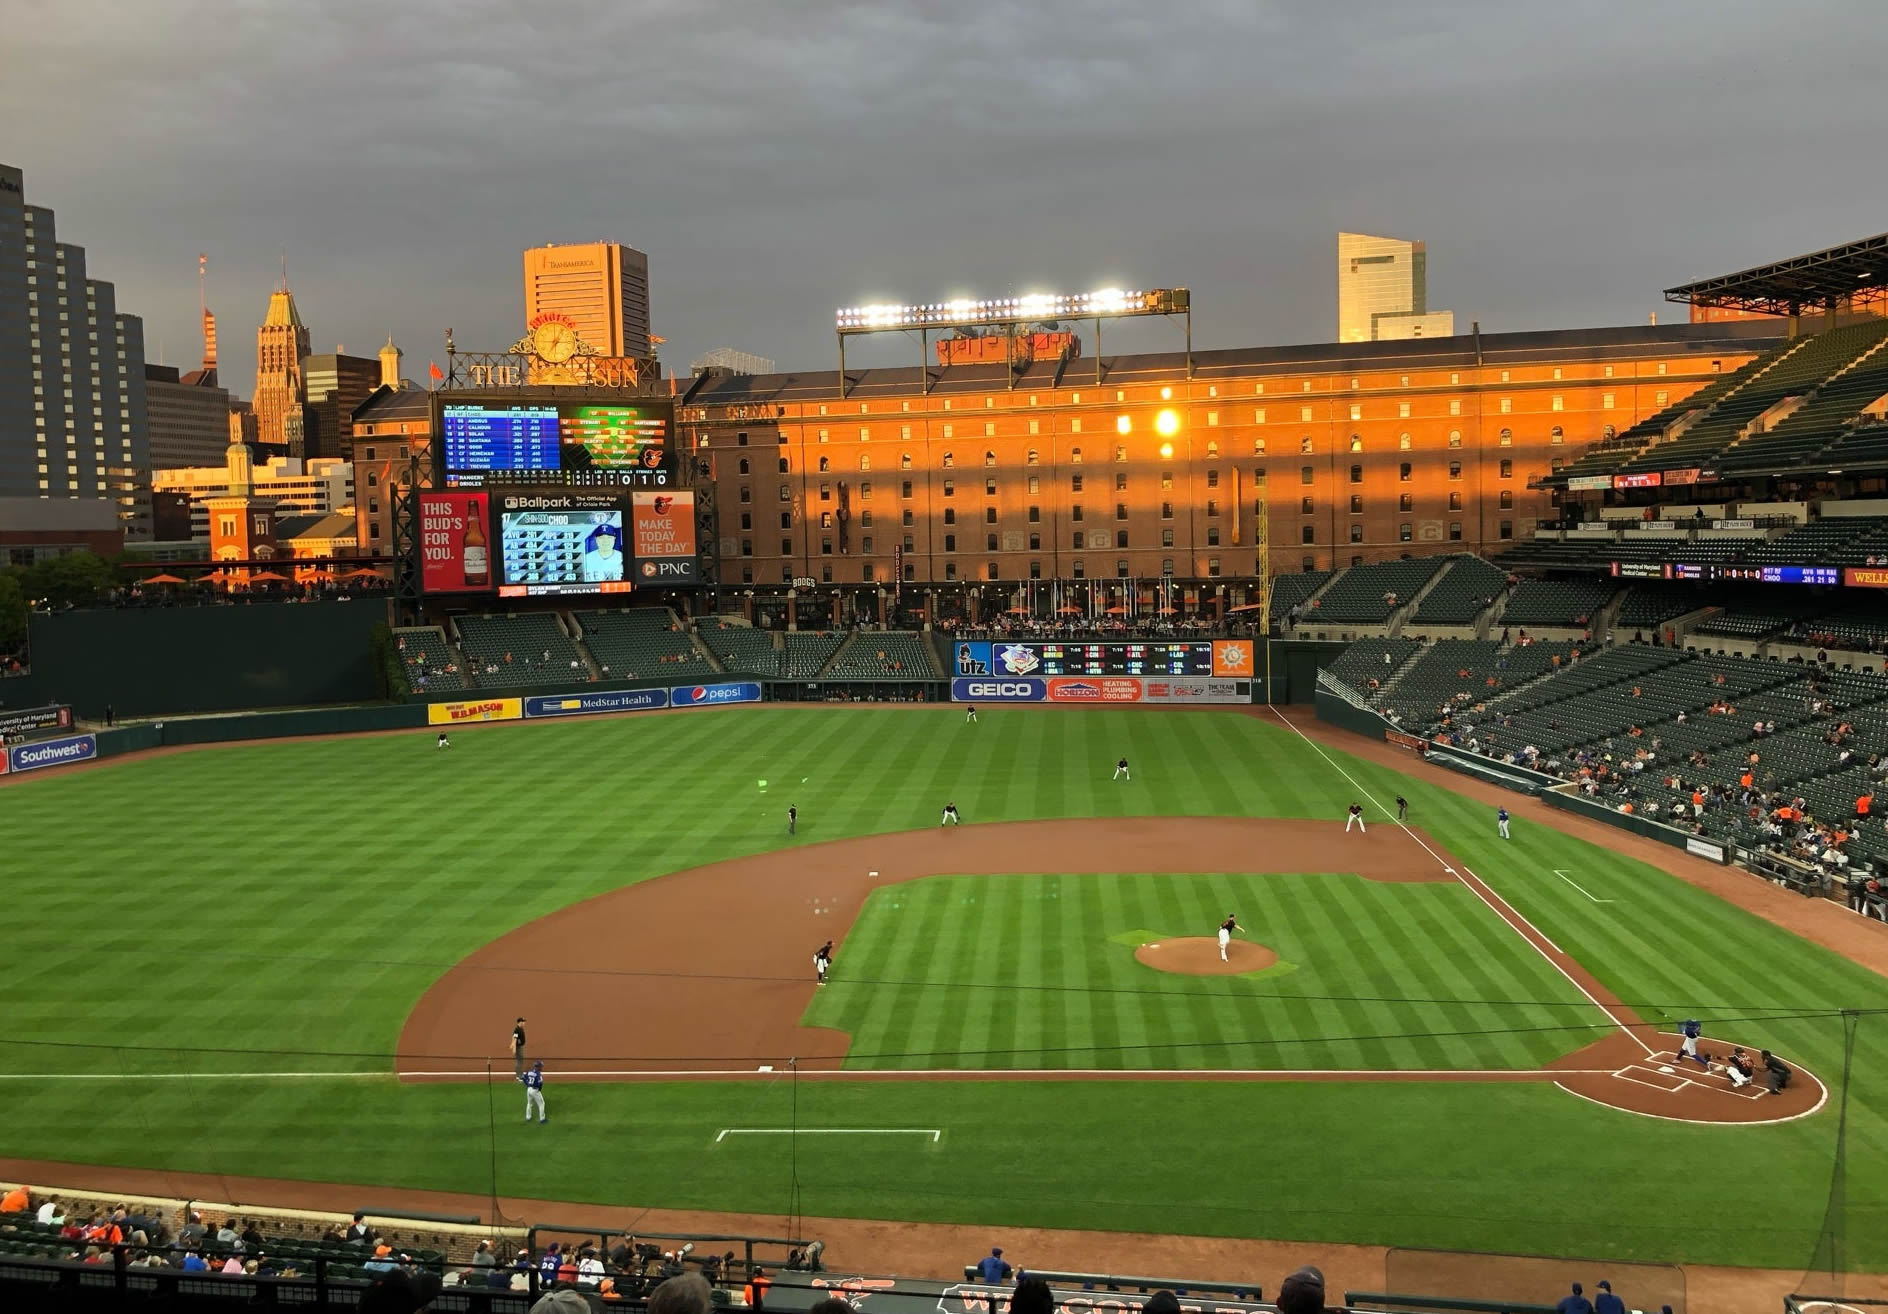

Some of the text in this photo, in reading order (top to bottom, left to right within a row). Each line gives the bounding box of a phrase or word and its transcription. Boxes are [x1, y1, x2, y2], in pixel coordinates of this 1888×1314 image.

[470, 365, 638, 388] THE SUN
[622, 475, 666, 485] 0 1 0
[423, 502, 452, 515] THIS
[519, 496, 571, 509] Ballpark
[424, 517, 463, 530] BUD'S
[502, 513, 511, 522] 17
[549, 515, 568, 525] CHOO
[639, 519, 672, 530] MAKE
[424, 532, 449, 545] FOR
[640, 531, 676, 542] TODAY
[424, 547, 455, 560] YOU.
[640, 543, 687, 553] THE DAY
[658, 562, 690, 575] PNC
[1731, 569, 1737, 578] 0
[1755, 570, 1760, 579] 0
[960, 659, 986, 675] utz
[709, 687, 741, 699] pepsi
[968, 683, 1031, 696] GEICO
[1055, 688, 1100, 696] HORIZON
[583, 695, 651, 708] MedStar Health
[31, 712, 56, 721] Maryland
[20, 743, 80, 763] Southwest
